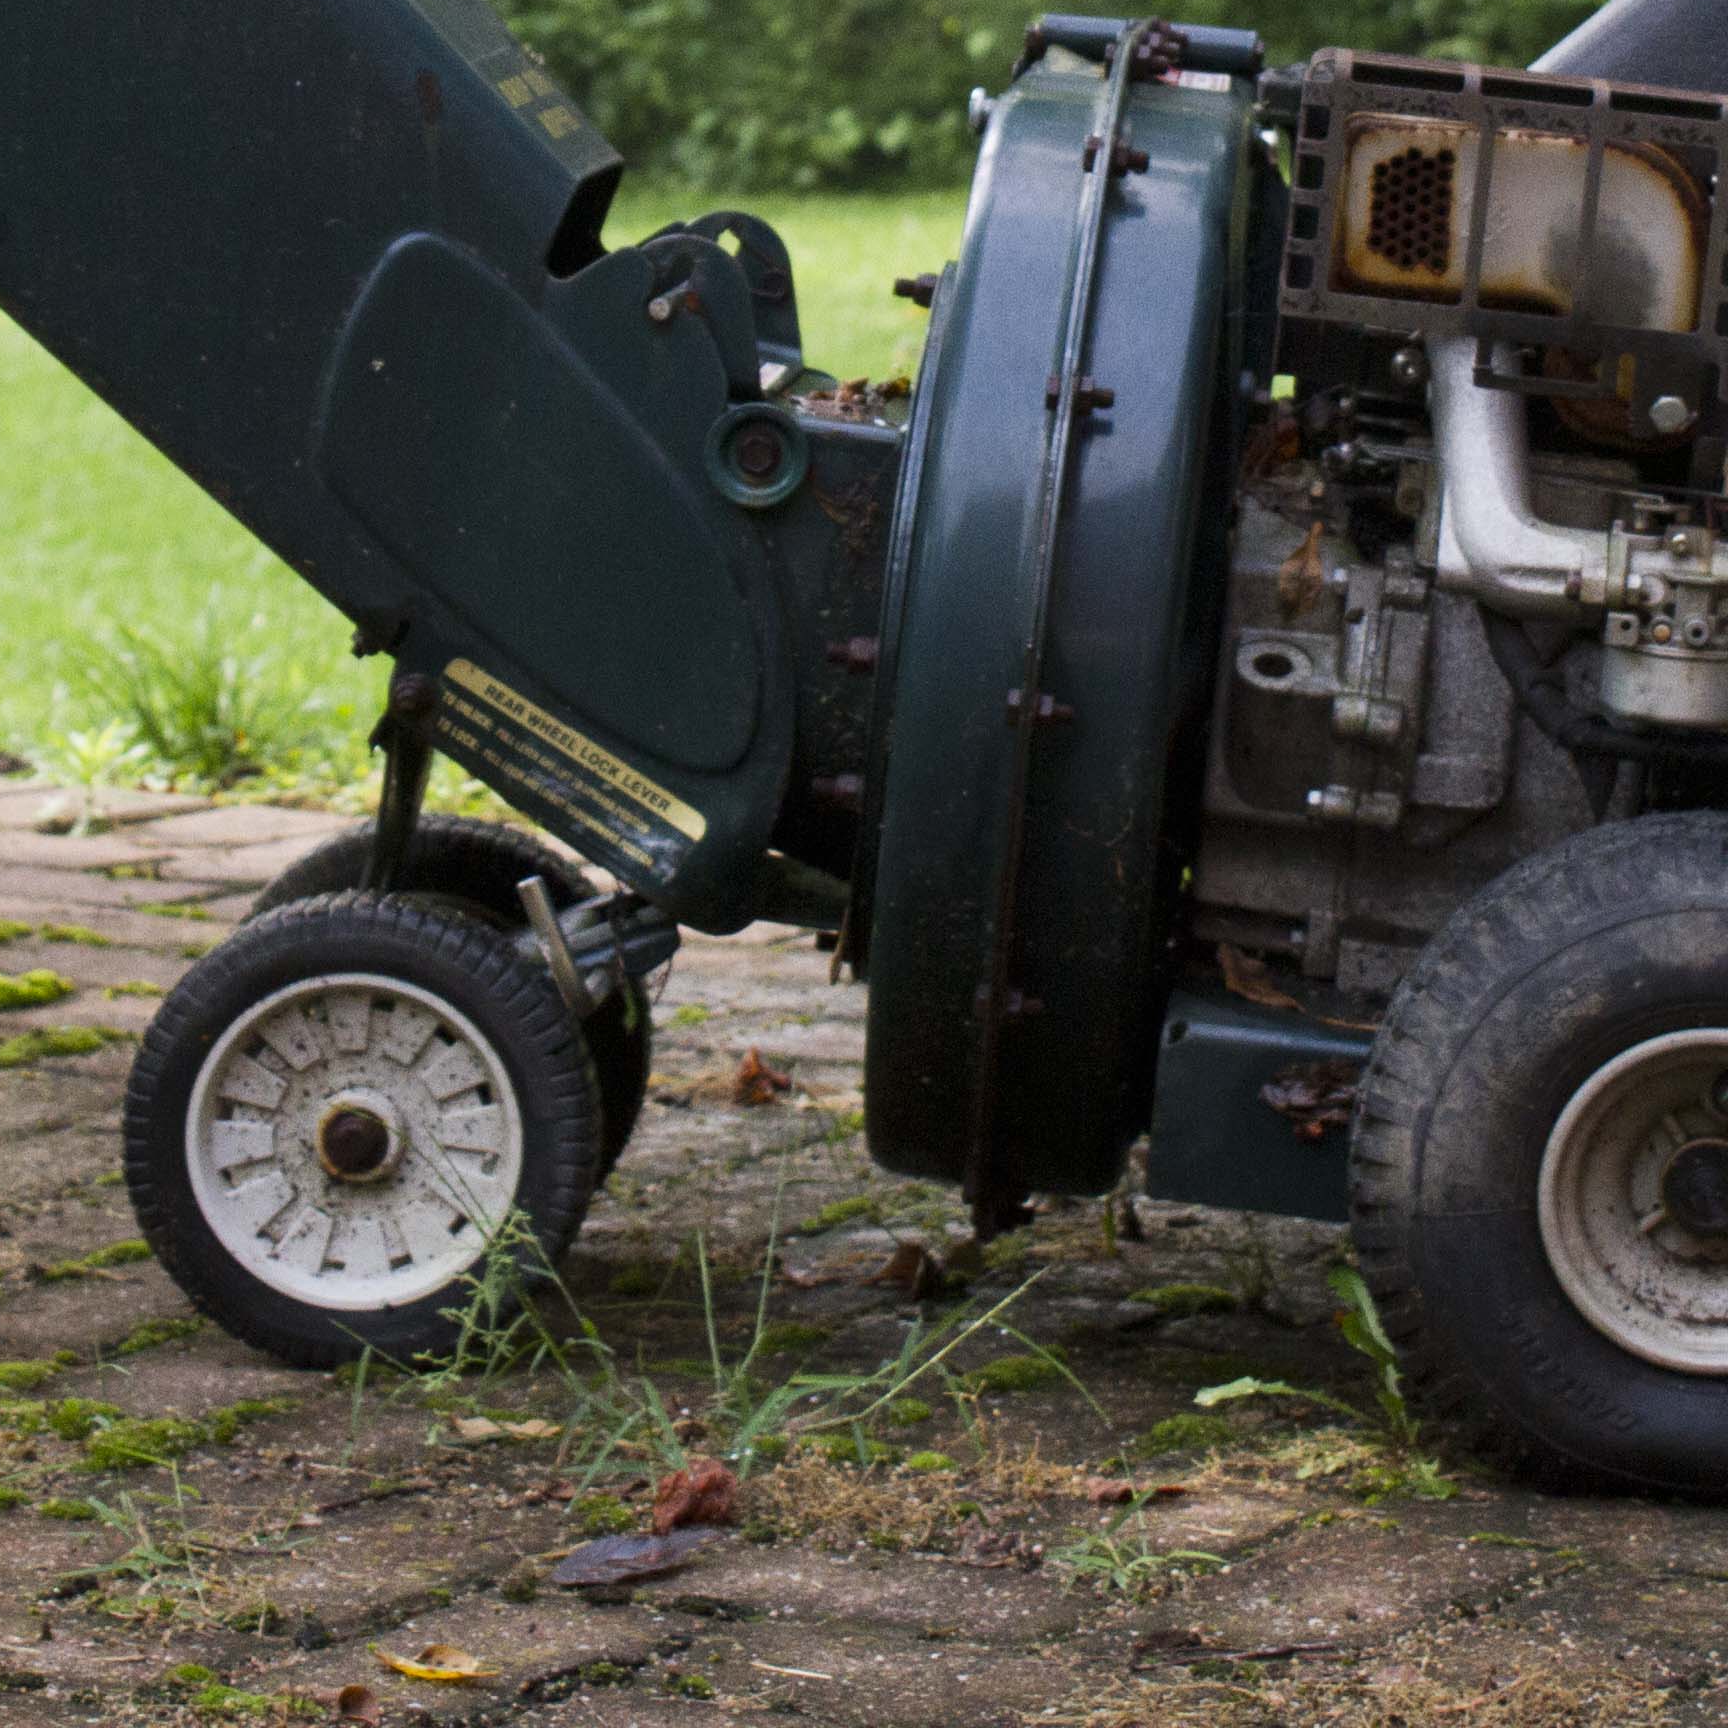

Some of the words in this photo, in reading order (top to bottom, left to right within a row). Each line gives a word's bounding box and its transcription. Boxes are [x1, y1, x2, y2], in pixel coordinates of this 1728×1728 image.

[484, 683, 524, 718] REAR
[527, 712, 574, 748] WHEEL
[579, 742, 620, 778] LOCK
[622, 773, 671, 812] LEVER
